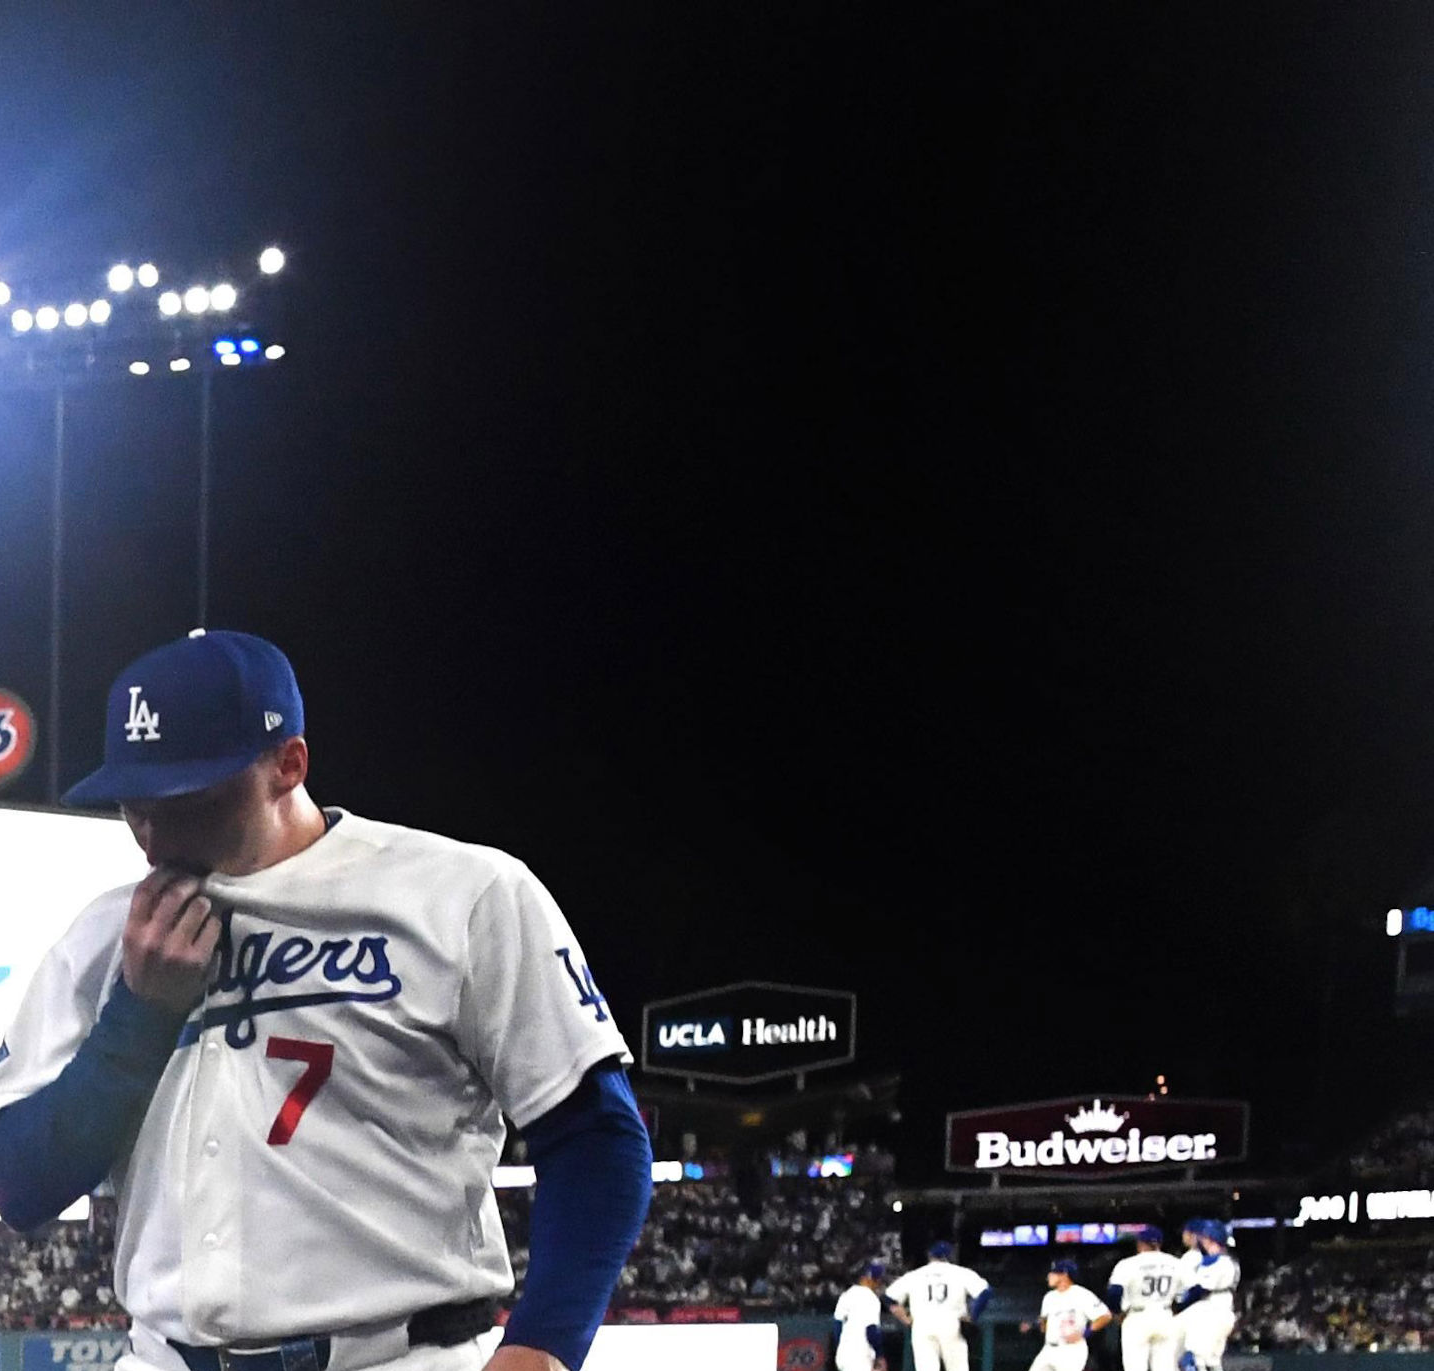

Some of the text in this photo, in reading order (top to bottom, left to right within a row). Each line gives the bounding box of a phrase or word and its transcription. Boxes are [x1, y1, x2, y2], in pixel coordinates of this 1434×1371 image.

[125, 686, 161, 742] LA
[658, 1014, 836, 1048] UCLA Health
[266, 1036, 334, 1146] 7
